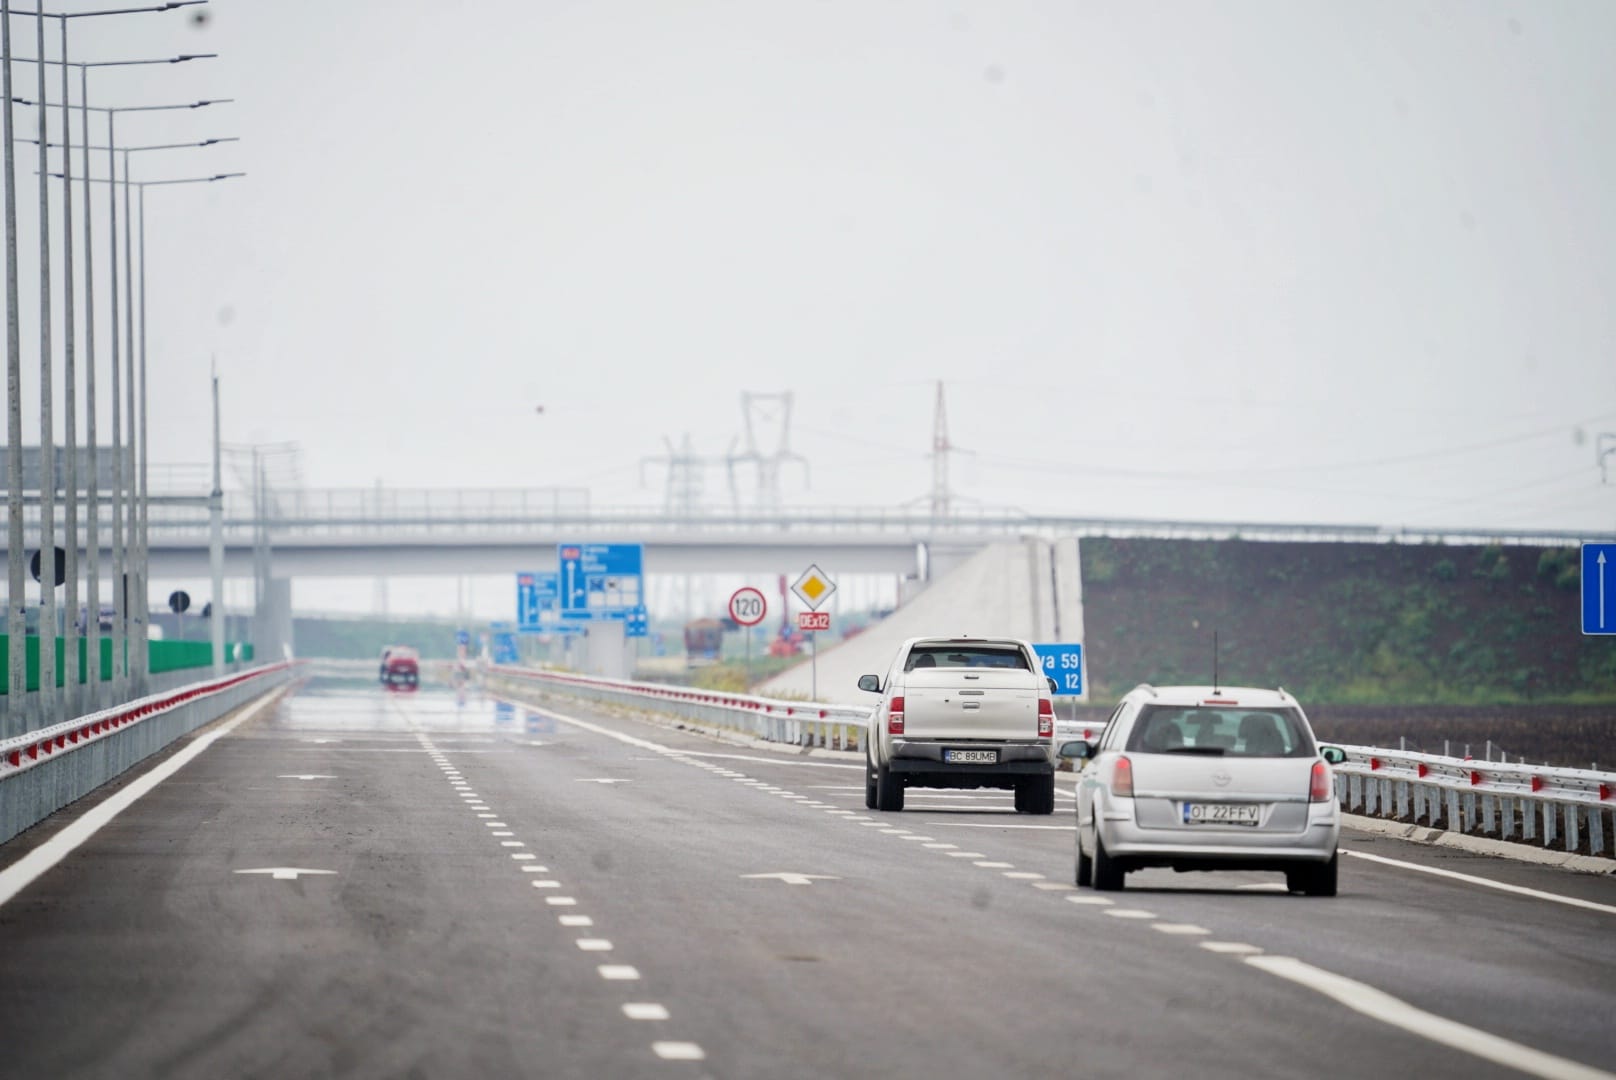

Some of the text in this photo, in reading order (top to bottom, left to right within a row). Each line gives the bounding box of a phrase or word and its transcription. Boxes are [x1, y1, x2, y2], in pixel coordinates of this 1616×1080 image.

[735, 598, 761, 616] 120
[1061, 653, 1079, 669] 59
[1065, 673, 1079, 689] 12
[950, 751, 996, 761] BC 89UMB
[1192, 805, 1257, 819] OT 22FFV
